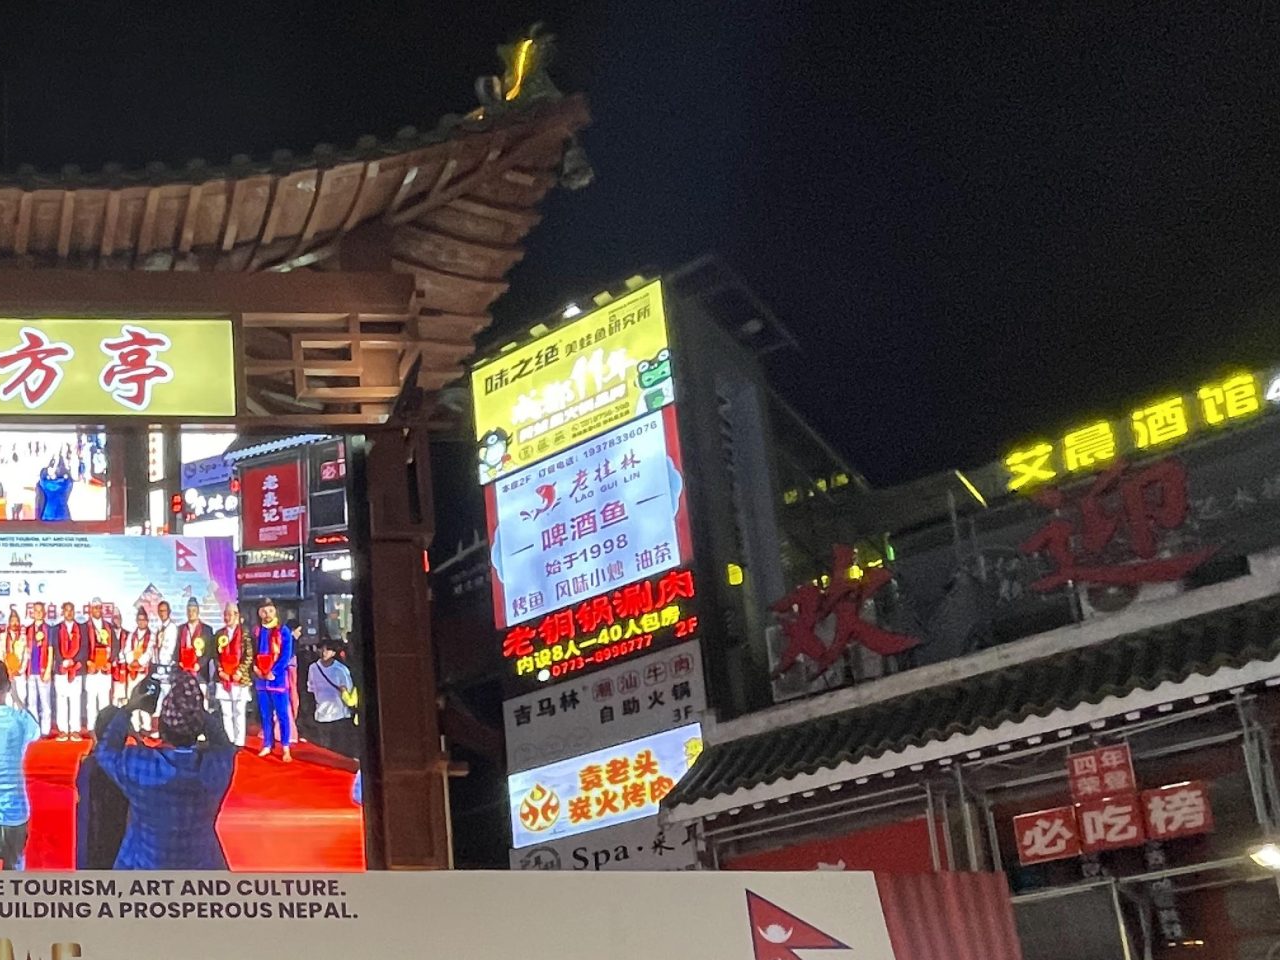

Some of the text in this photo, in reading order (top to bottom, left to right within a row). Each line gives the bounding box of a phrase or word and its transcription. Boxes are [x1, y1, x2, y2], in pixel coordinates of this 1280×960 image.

[485, 342, 561, 395] 味之绝
[569, 449, 641, 498] 老桂林
[575, 471, 640, 503] LAO GUI LIN
[541, 500, 628, 551] 啤酒鱼
[545, 534, 628, 577] 始于1998
[513, 543, 673, 617] 烤鱼 风味小炒 油茶
[503, 571, 695, 657] 老铜锅涮肉
[675, 617, 699, 637] 2F
[514, 690, 580, 726] 吉马林
[599, 681, 691, 725] 自助火锅
[672, 705, 693, 723] 3F
[579, 749, 660, 791] 袁老头
[568, 776, 676, 824] 炭火烤肉
[1023, 790, 1206, 857] 必吃榜
[9, 879, 123, 899] TOURISM,
[129, 879, 175, 896] ART
[180, 879, 231, 896] AND
[236, 879, 347, 896] CULTURE.
[97, 902, 114, 918] A
[119, 902, 273, 918] PROSPEROUS
[278, 902, 359, 919] NEPAL.
